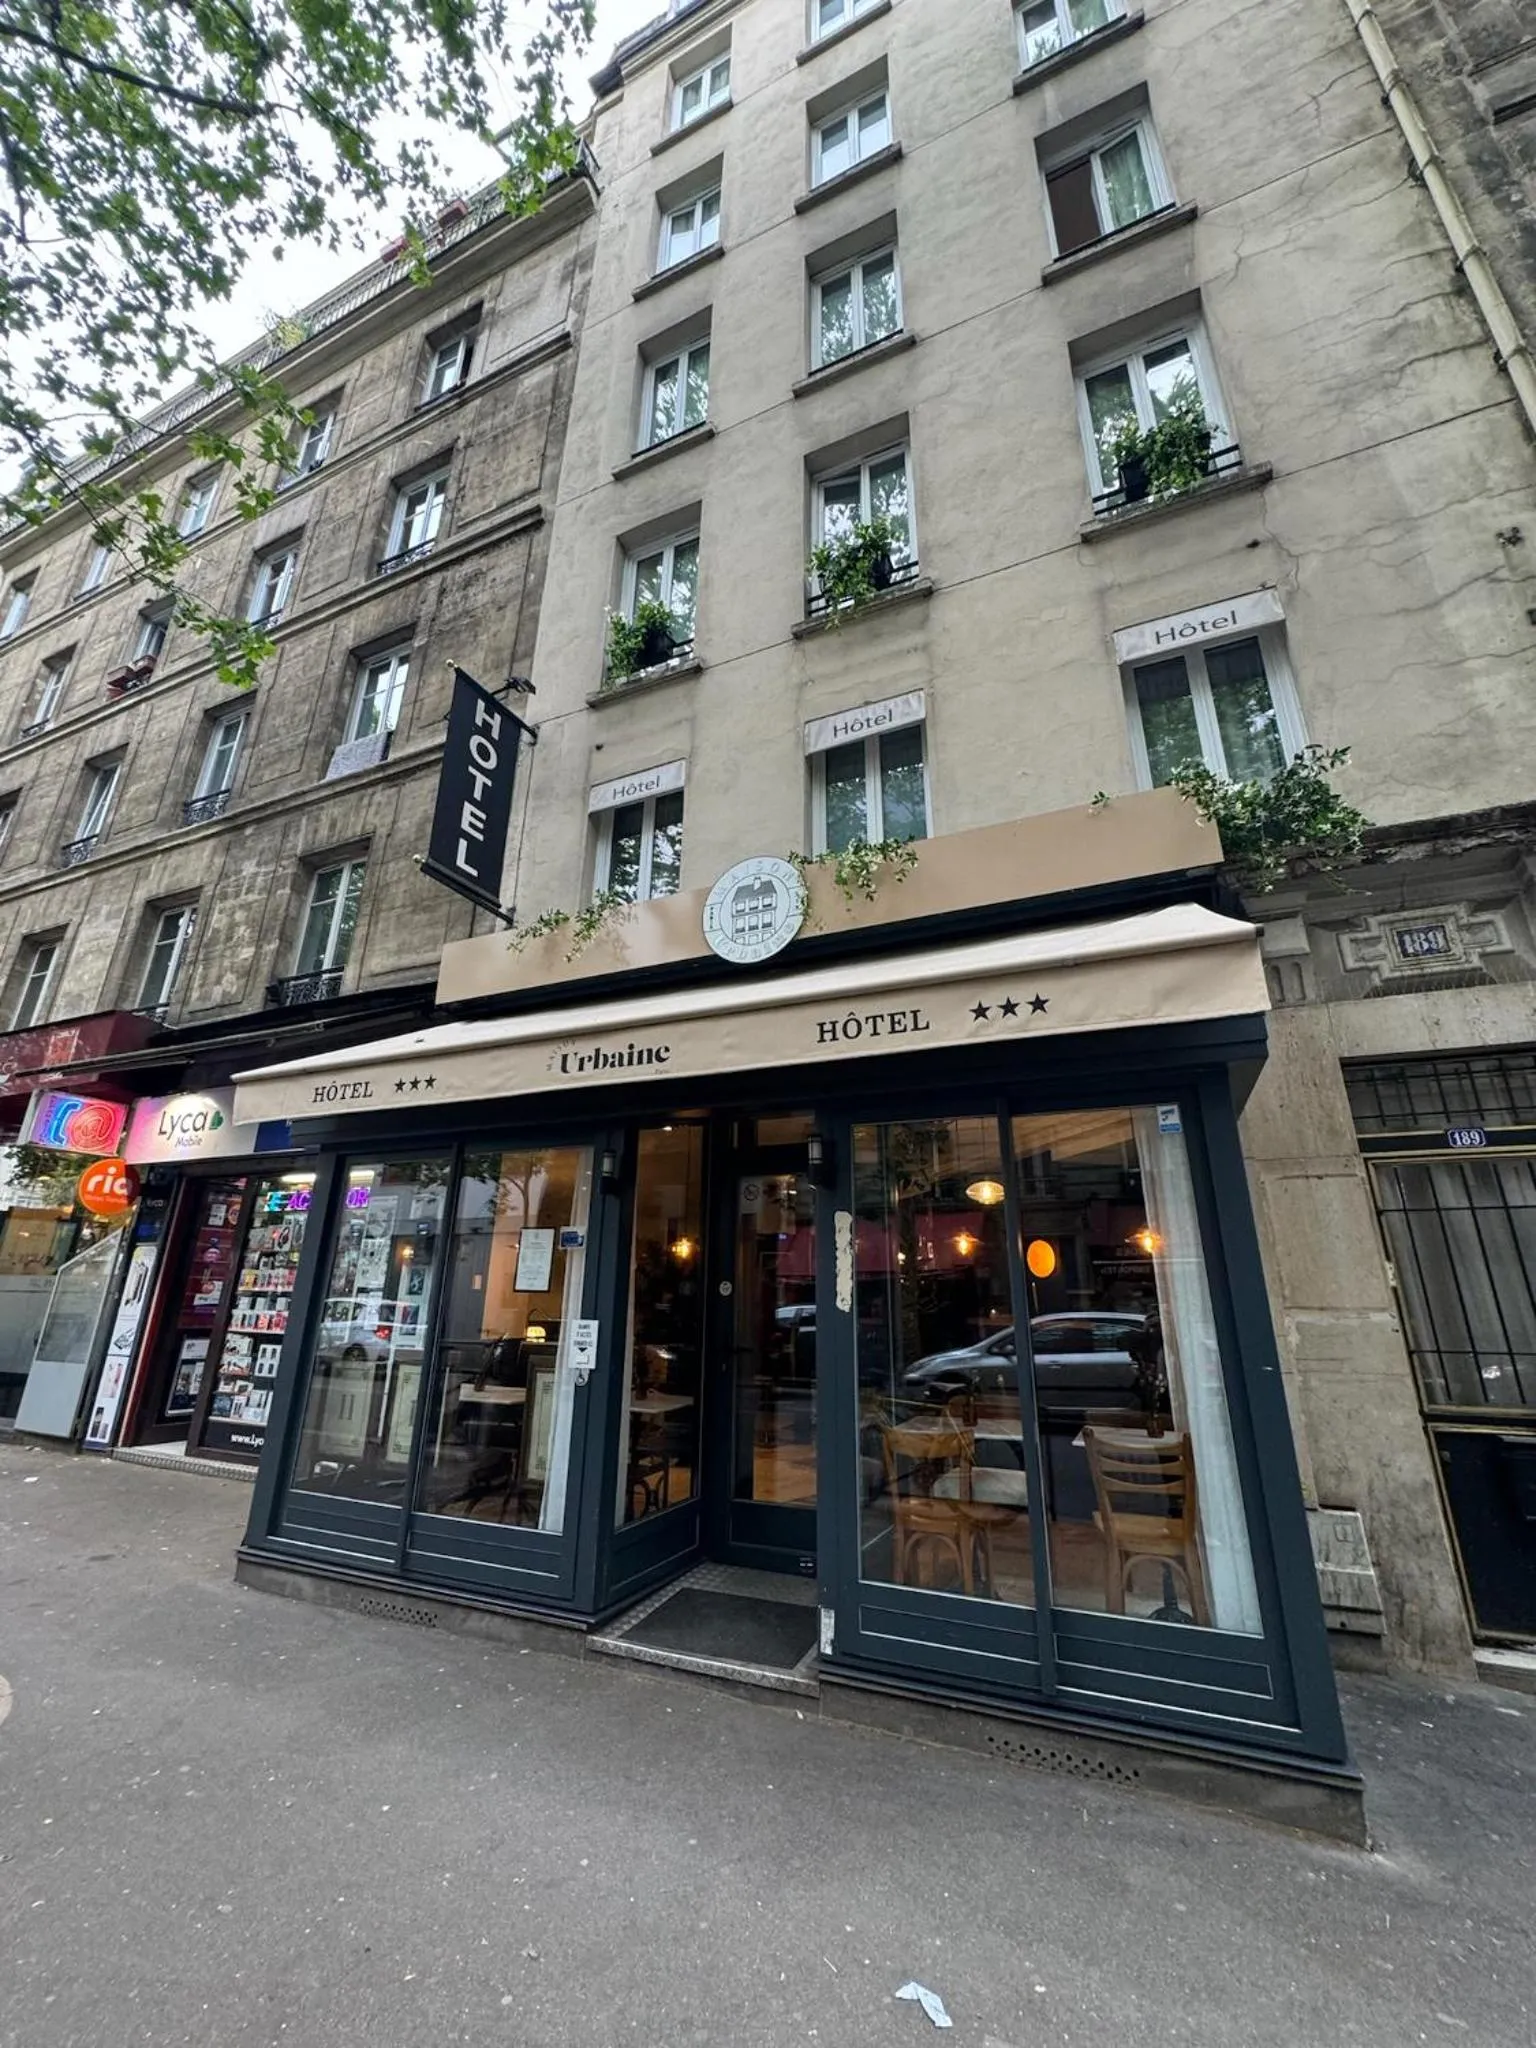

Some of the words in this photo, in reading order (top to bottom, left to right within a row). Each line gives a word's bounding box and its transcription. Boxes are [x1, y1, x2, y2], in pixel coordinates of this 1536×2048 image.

[1155, 610, 1238, 644] Hôtel
[833, 709, 893, 738] Hôtel
[455, 698, 502, 877] HOTEL
[613, 775, 660, 800] Hôtel
[1402, 931, 1446, 953] 189
[816, 1009, 930, 1043] HÔTEL
[559, 1043, 670, 1073] Urbaine
[312, 1081, 374, 1103] HÔTEL
[158, 1108, 207, 1141] Lyca
[1453, 1130, 1481, 1146] 189
[175, 1137, 203, 1149] Mobile
[86, 1167, 133, 1196] ria
